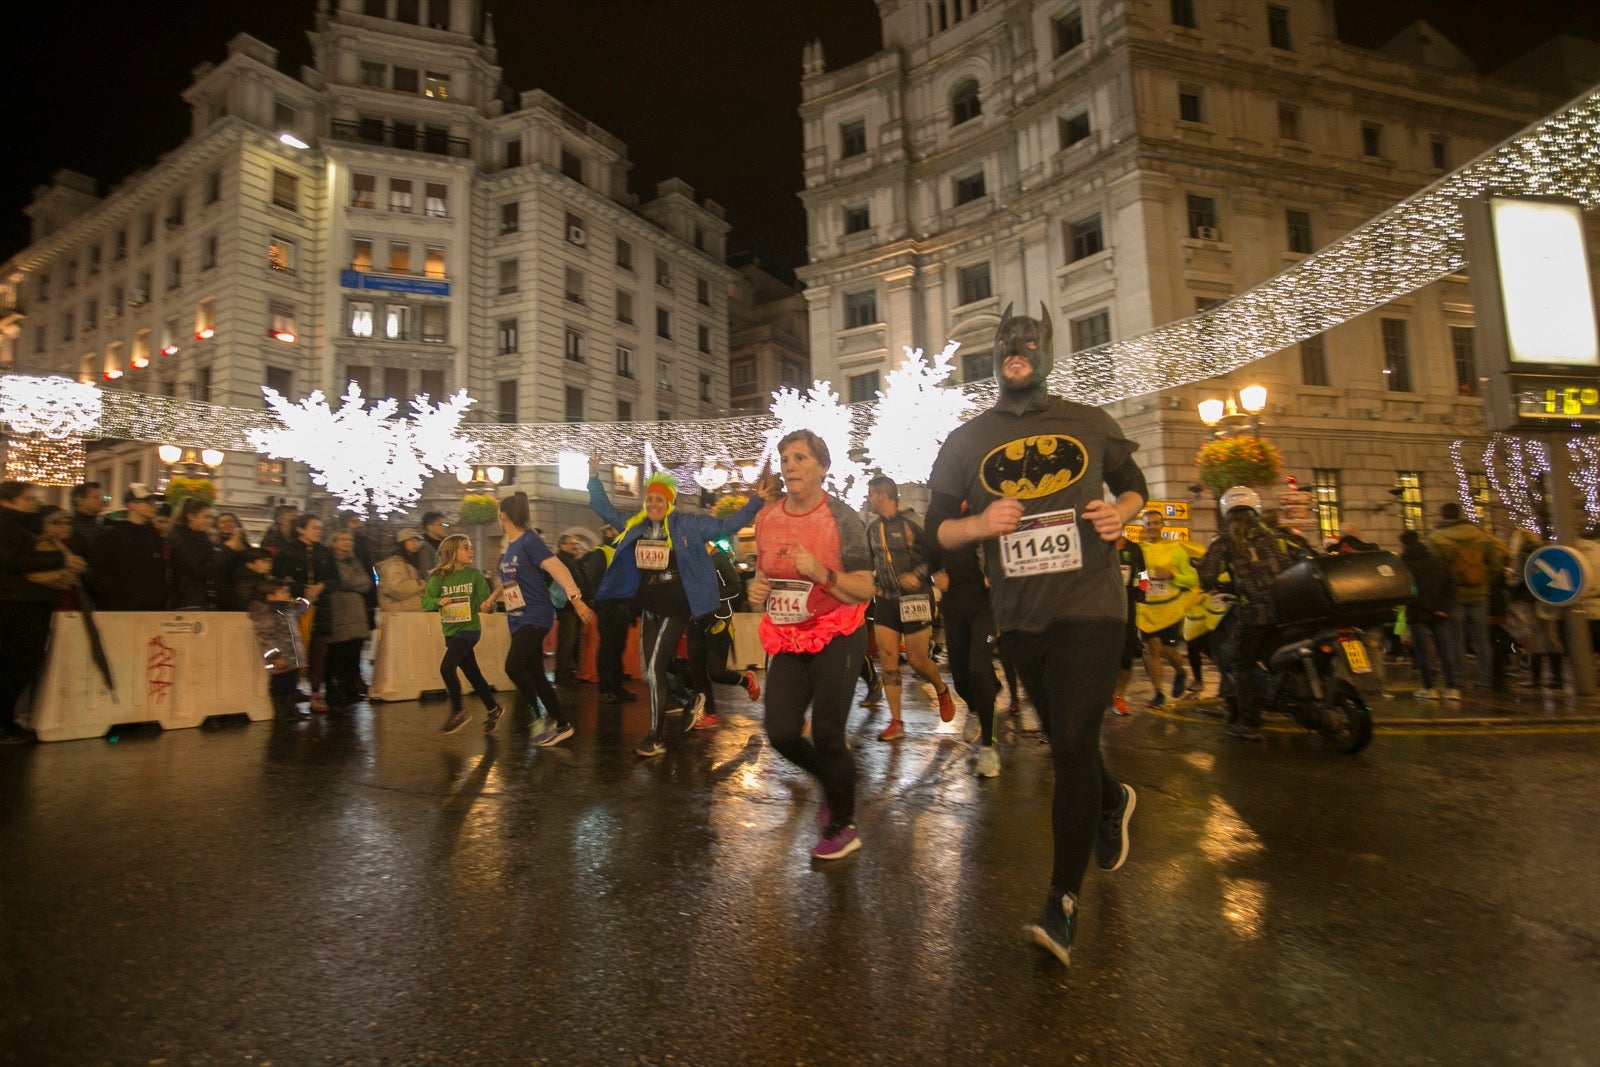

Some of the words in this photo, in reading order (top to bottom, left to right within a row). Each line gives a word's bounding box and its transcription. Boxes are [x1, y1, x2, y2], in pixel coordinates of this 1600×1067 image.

[1012, 533, 1071, 560] 1149
[640, 549, 664, 562] 1230
[770, 596, 800, 613] 2114
